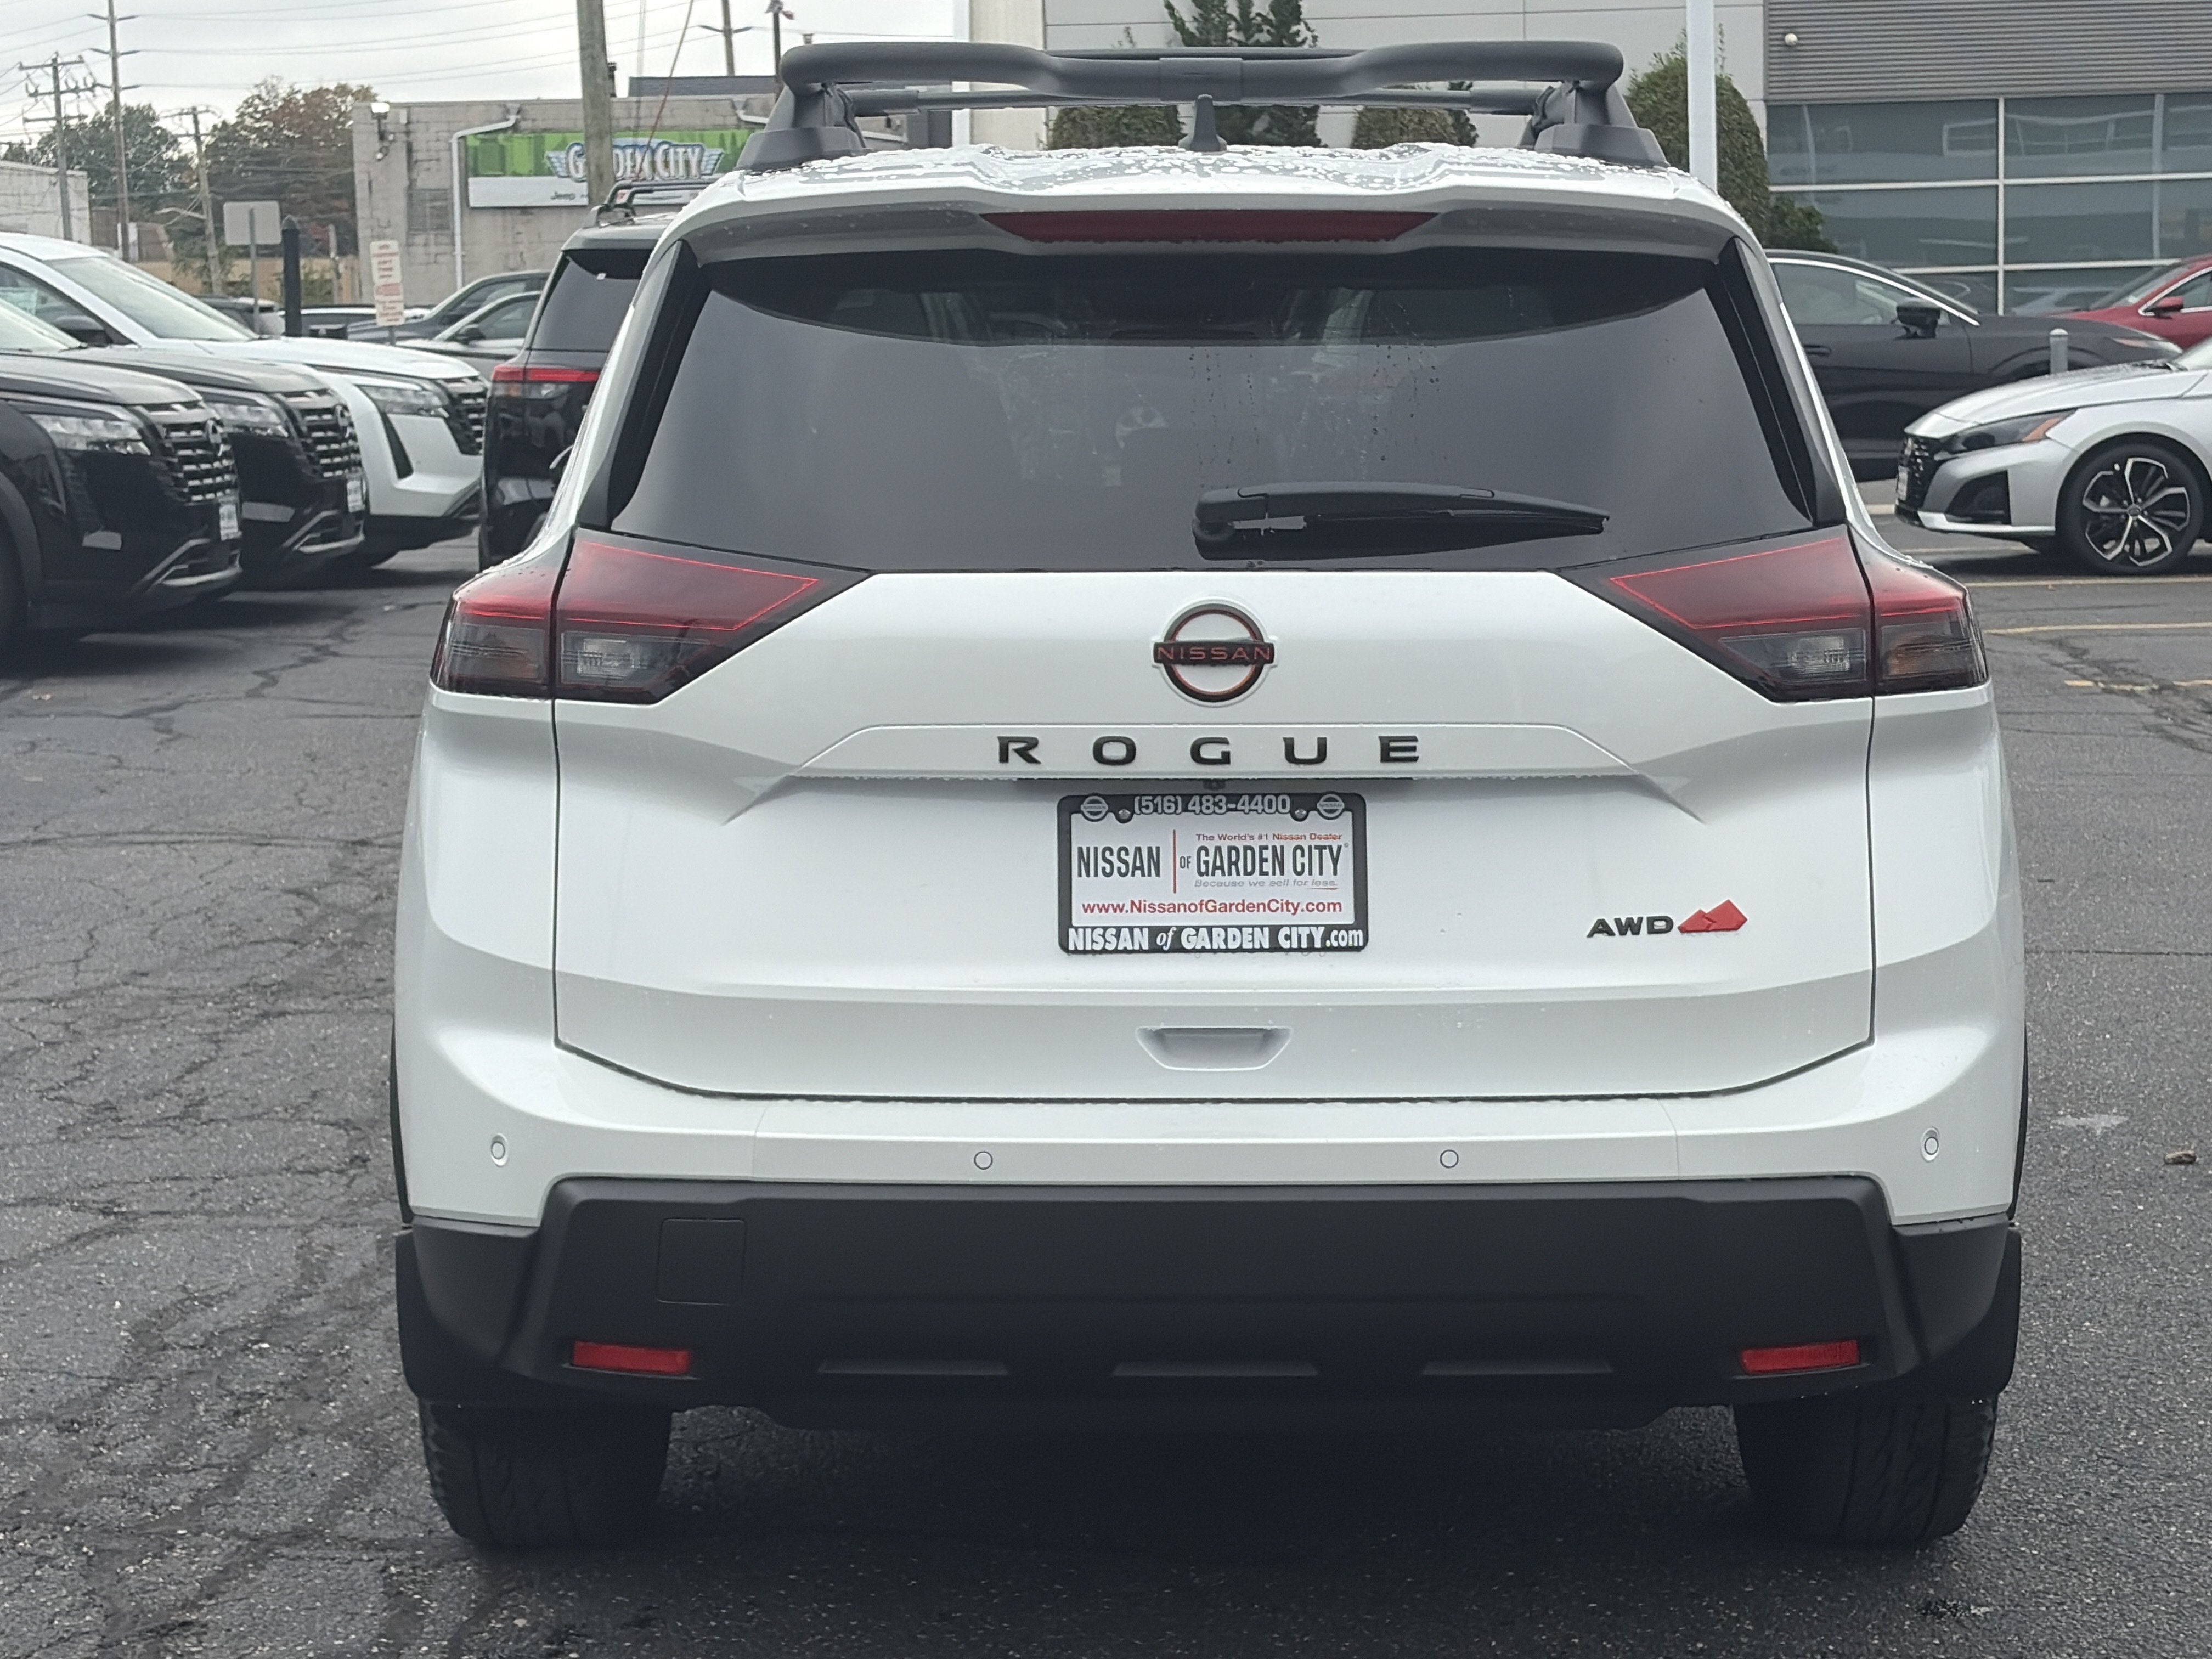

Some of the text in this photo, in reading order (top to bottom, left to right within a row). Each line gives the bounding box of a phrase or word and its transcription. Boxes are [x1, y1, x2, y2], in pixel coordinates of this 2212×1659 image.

[567, 142, 701, 181] GDEN CITY
[1158, 647, 1270, 660] NISSAN
[997, 735, 1419, 765] ROGUE
[1134, 794, 1291, 815] (516) 483-4400
[1077, 844, 1342, 878] NISSAN OF GARDEN CITY
[1082, 899, 1342, 915] www.NissanofGardenCity.com
[1587, 916, 1674, 938] AWD
[1069, 927, 1363, 951] NISSAN of GARDEN CITY.com
